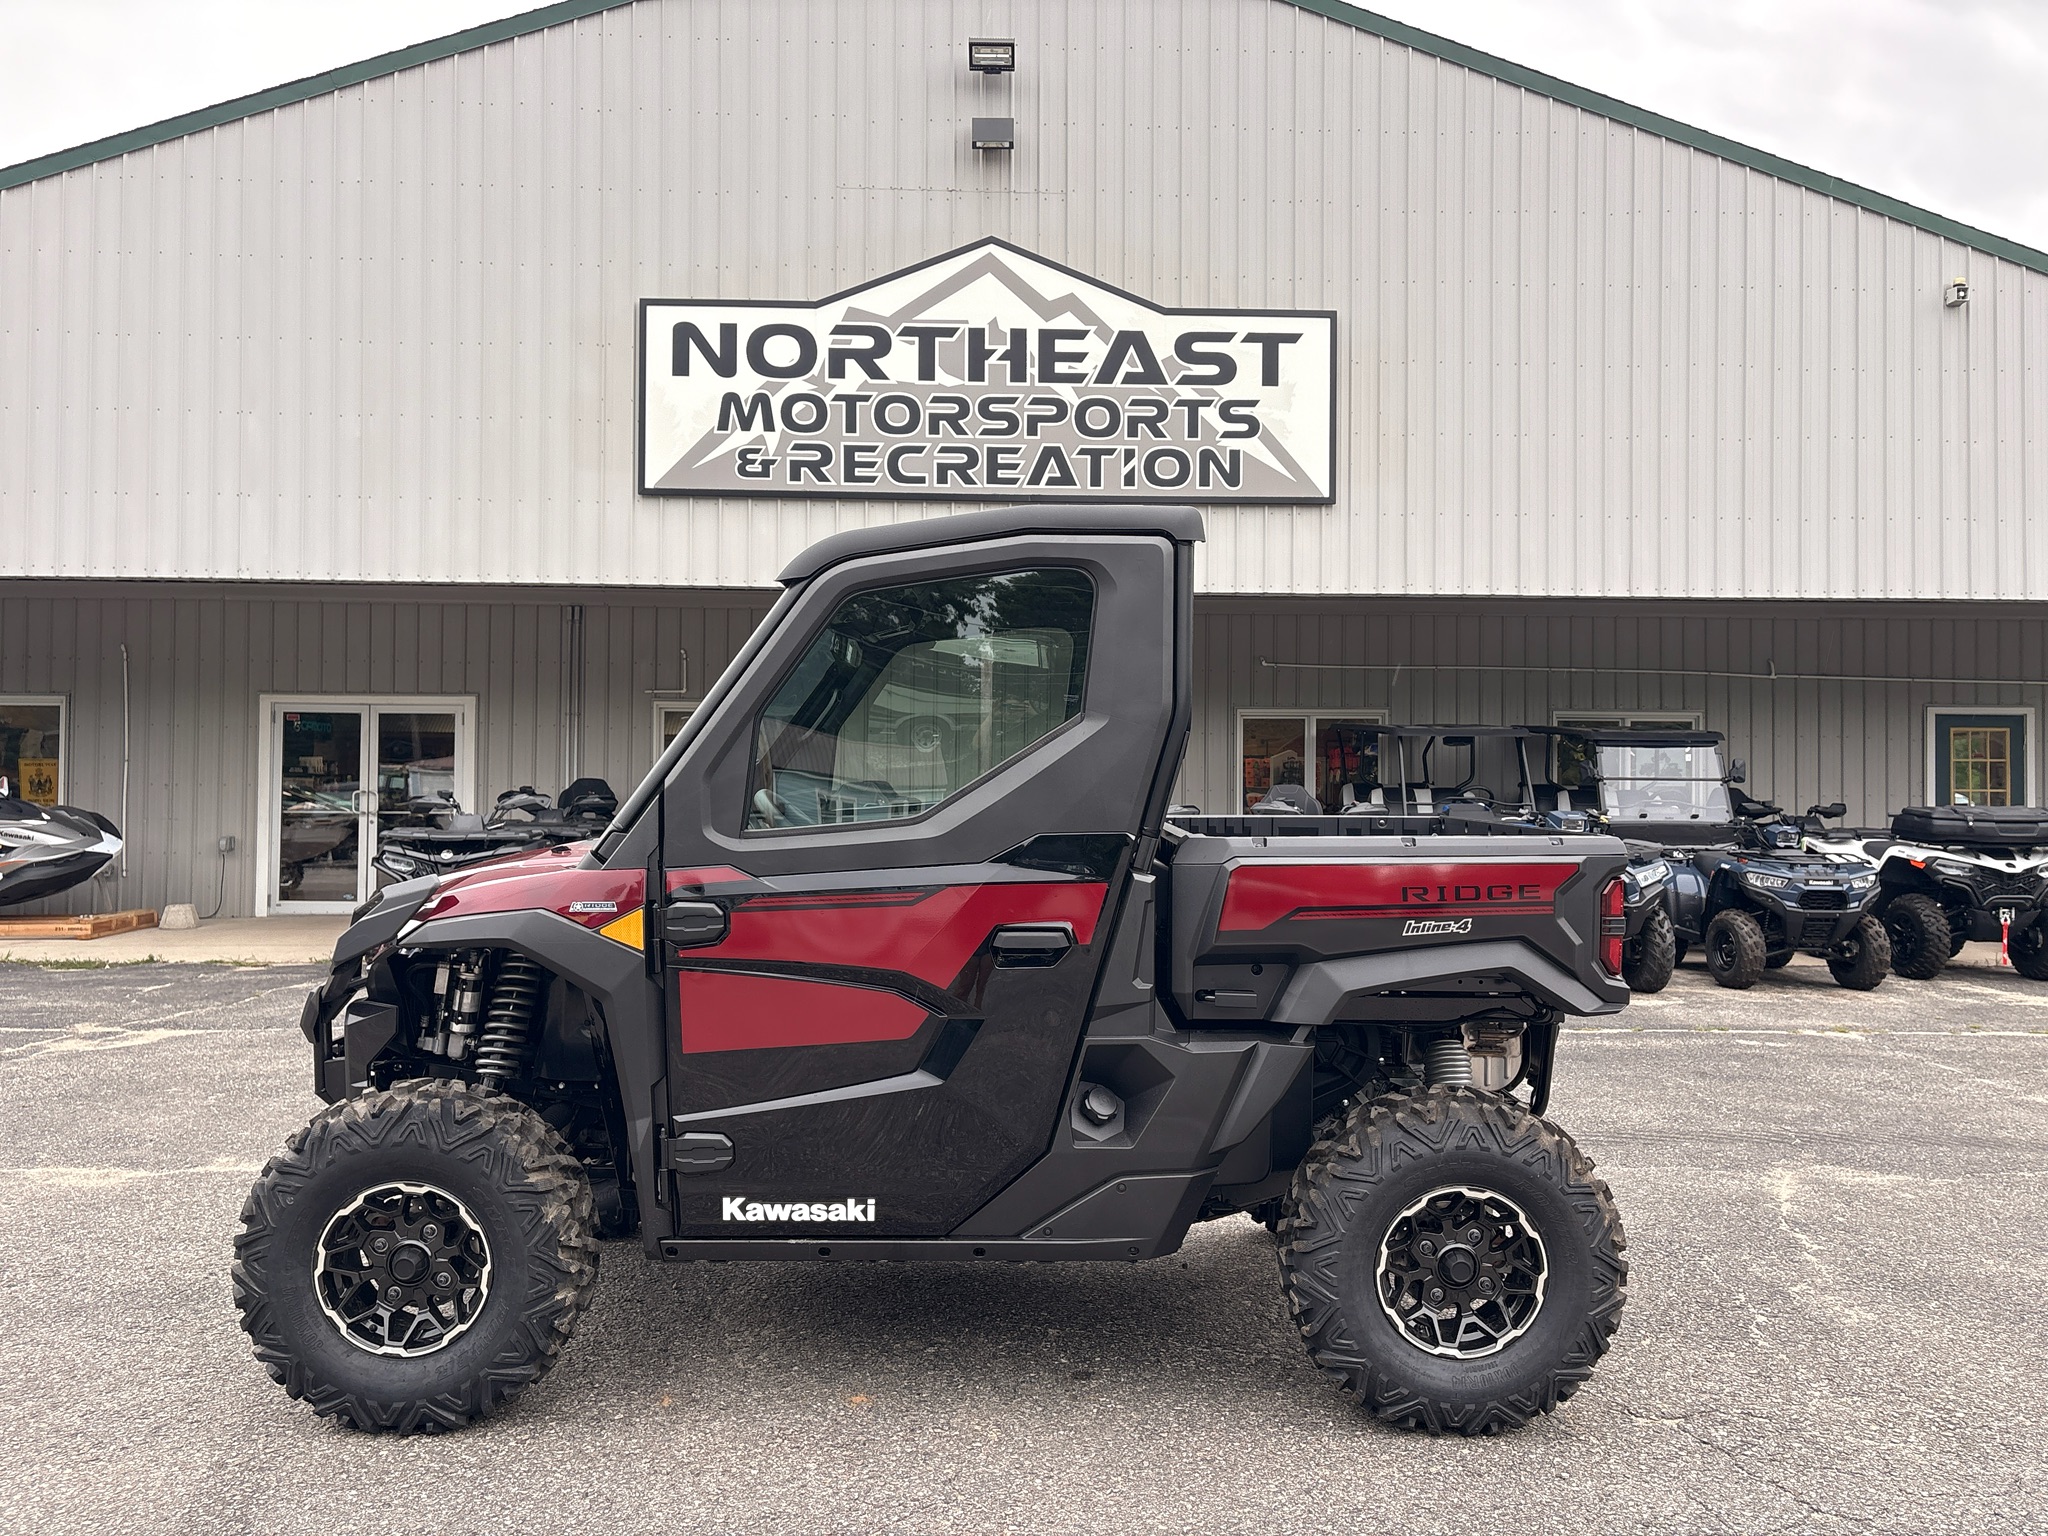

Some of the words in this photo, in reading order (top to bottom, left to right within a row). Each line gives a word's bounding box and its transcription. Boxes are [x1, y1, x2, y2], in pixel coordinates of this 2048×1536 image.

[672, 321, 1303, 387] NORTHEAST
[716, 392, 1261, 439] MOTORSPORTS
[789, 443, 1241, 488] RECREATION
[0, 830, 35, 842] Kawasaki
[1402, 884, 1541, 902] RIDGE
[1402, 918, 1472, 936] Inline-4
[722, 1196, 876, 1222] Kawasaki
